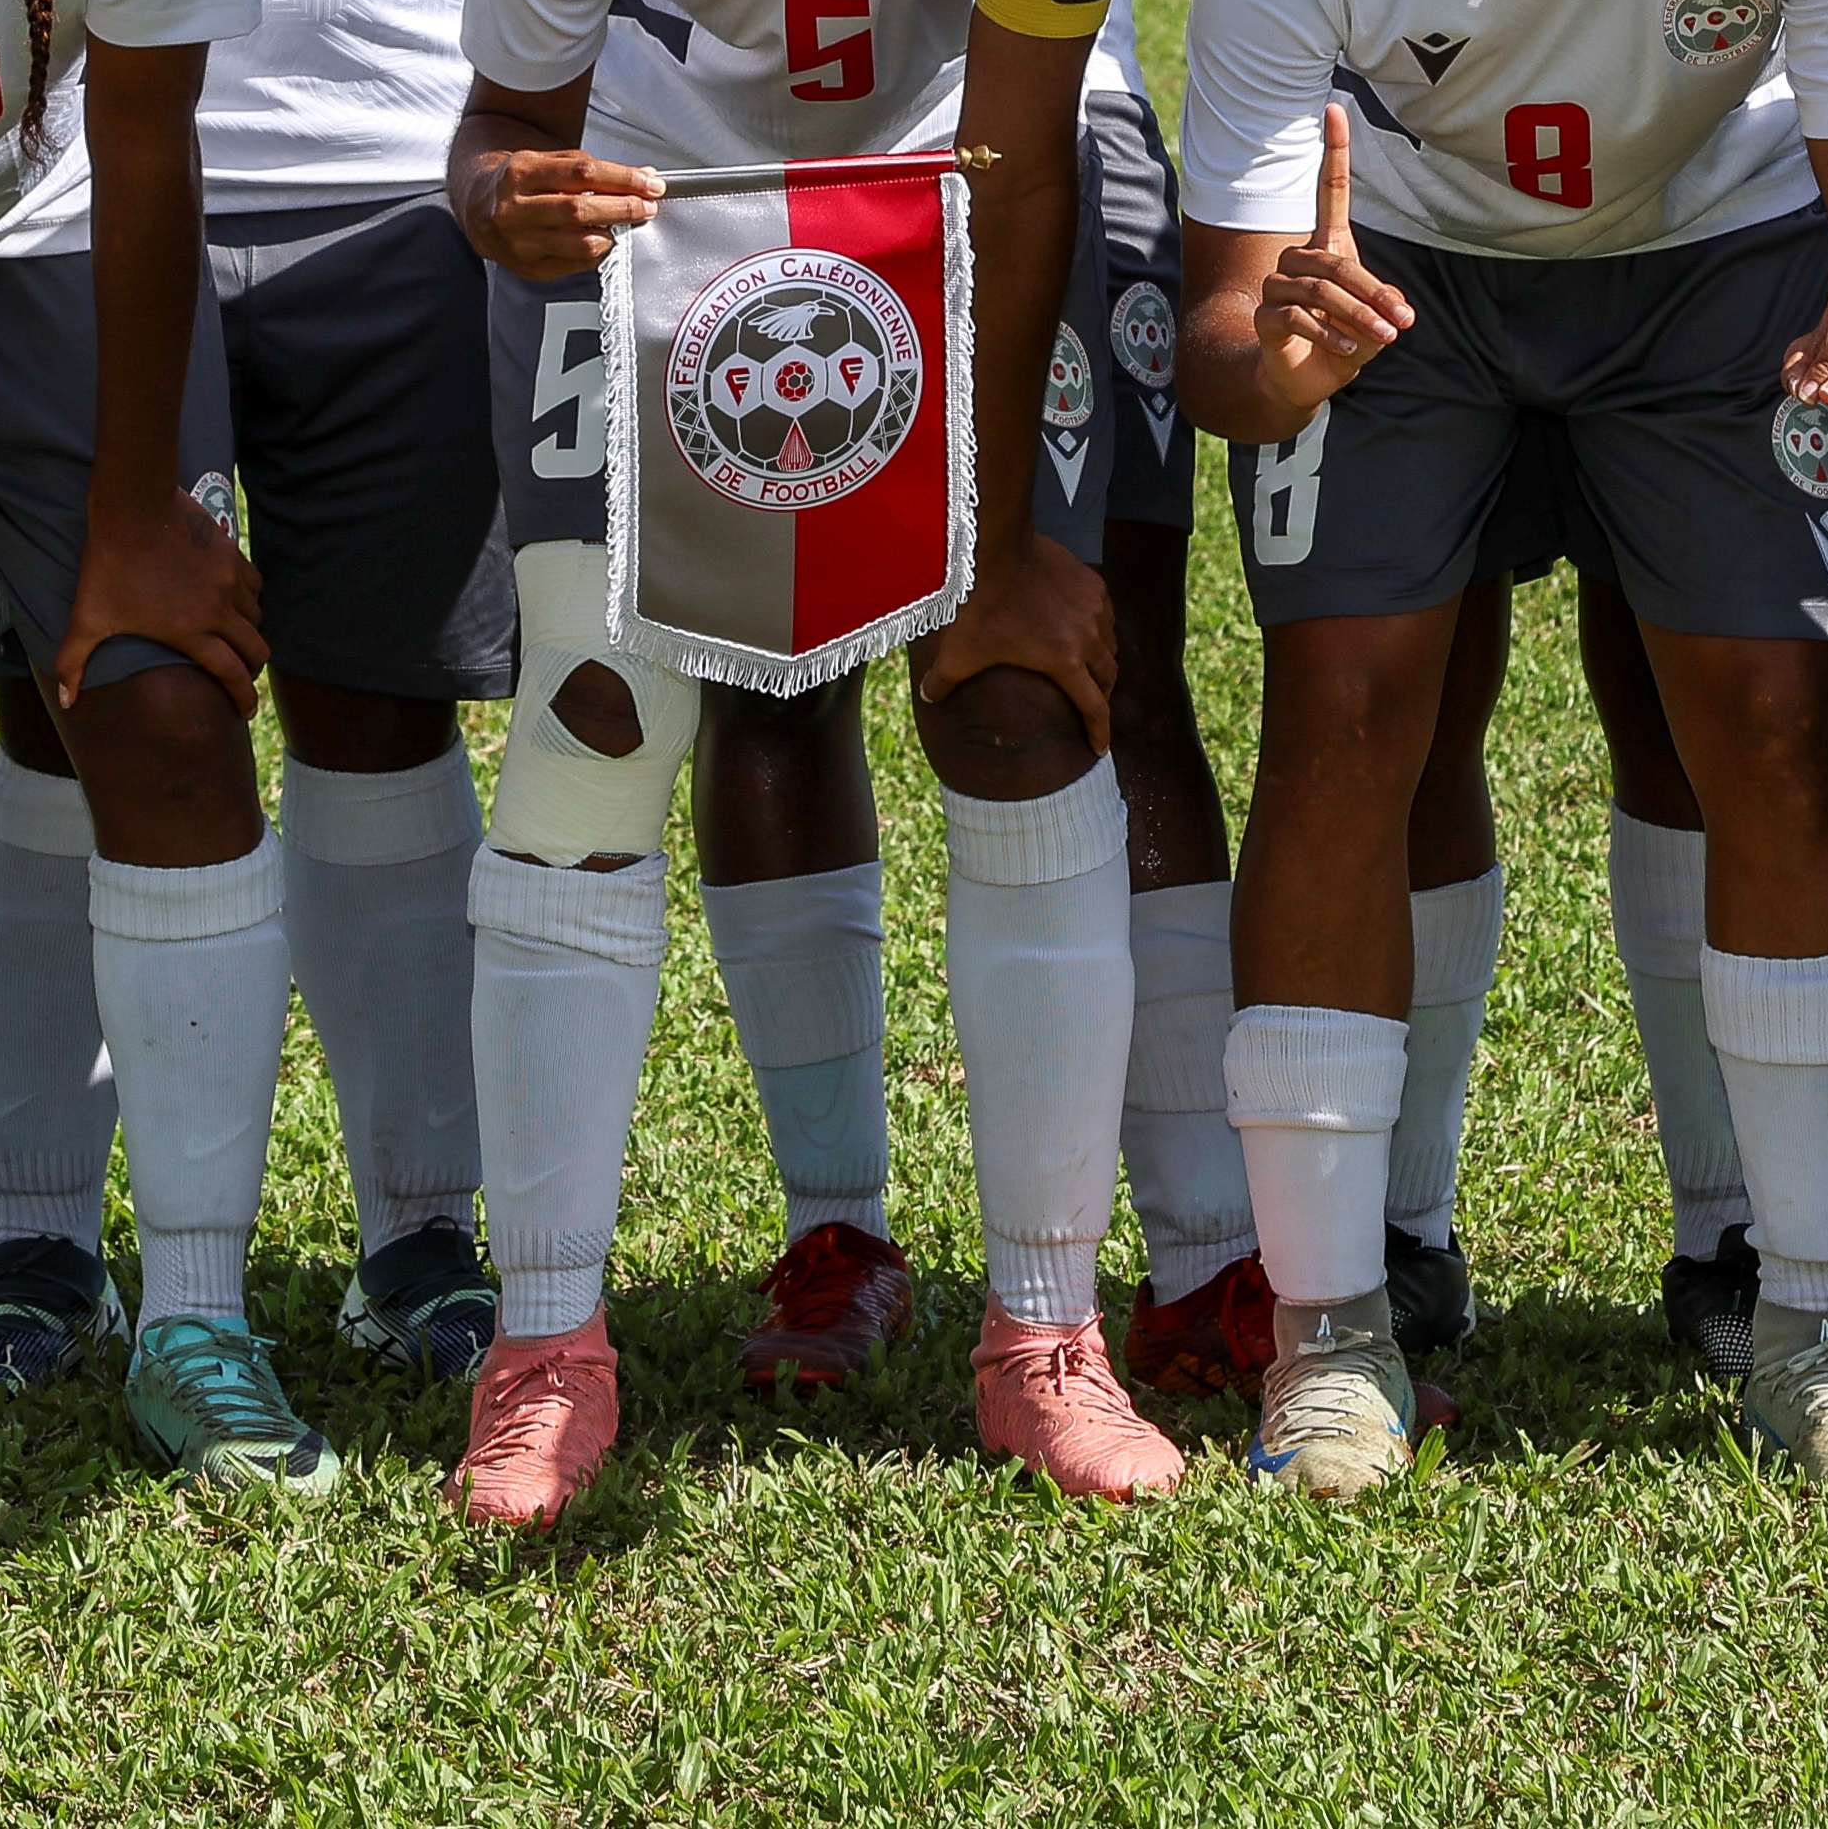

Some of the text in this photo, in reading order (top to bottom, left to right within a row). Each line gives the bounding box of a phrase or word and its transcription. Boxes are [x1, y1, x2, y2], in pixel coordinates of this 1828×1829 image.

[1504, 102, 1593, 209] 8
[674, 257, 913, 386] FÉDÉRATION CALÉDONIENNE
[531, 301, 605, 478] 5
[713, 453, 881, 502] DE FOOTBALL
